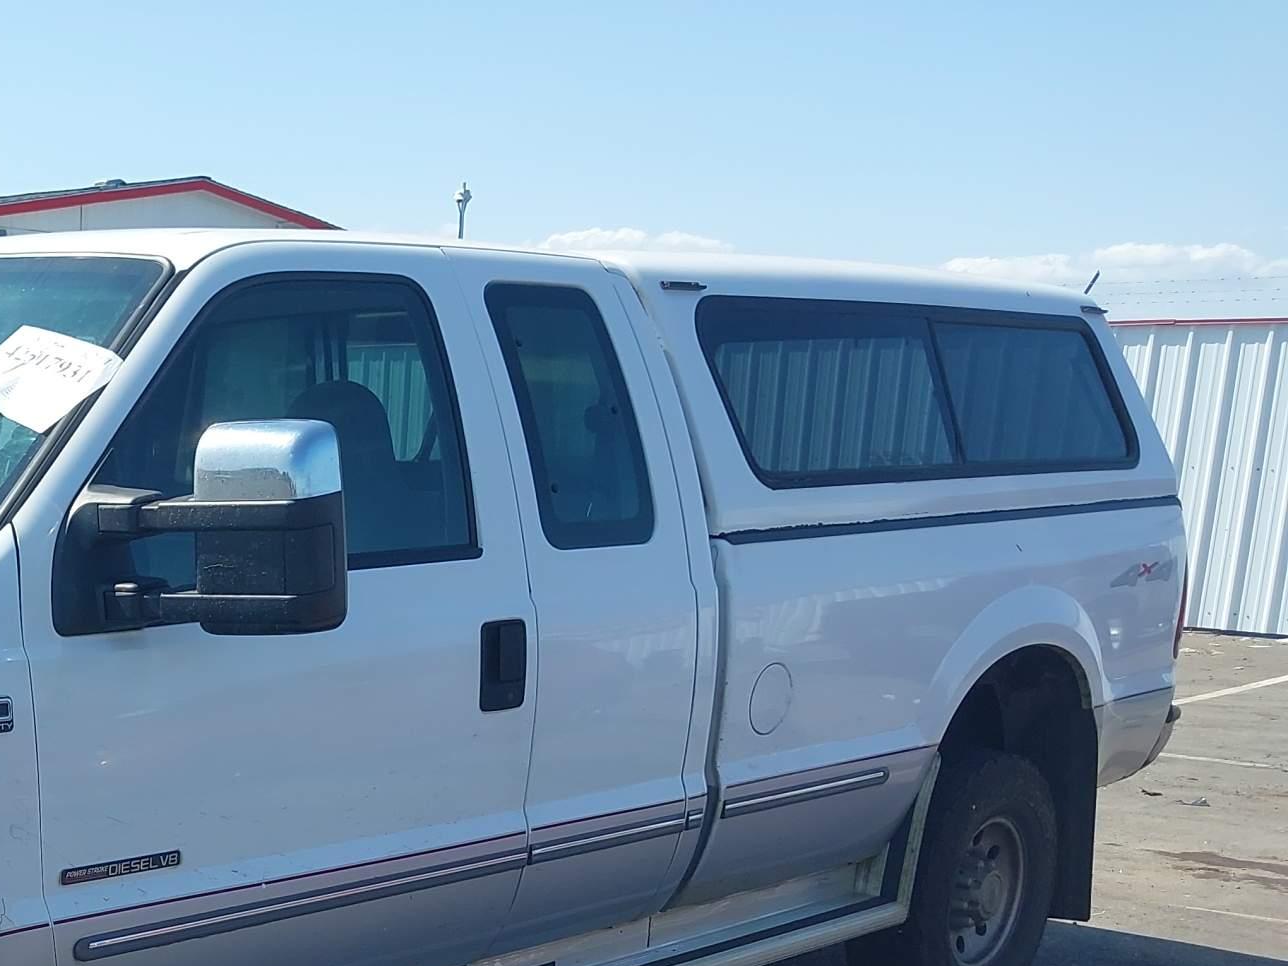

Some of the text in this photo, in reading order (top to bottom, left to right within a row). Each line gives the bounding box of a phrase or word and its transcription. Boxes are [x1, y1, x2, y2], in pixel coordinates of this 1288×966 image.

[65, 852, 178, 879] POWER STROKE DIESEL V8
